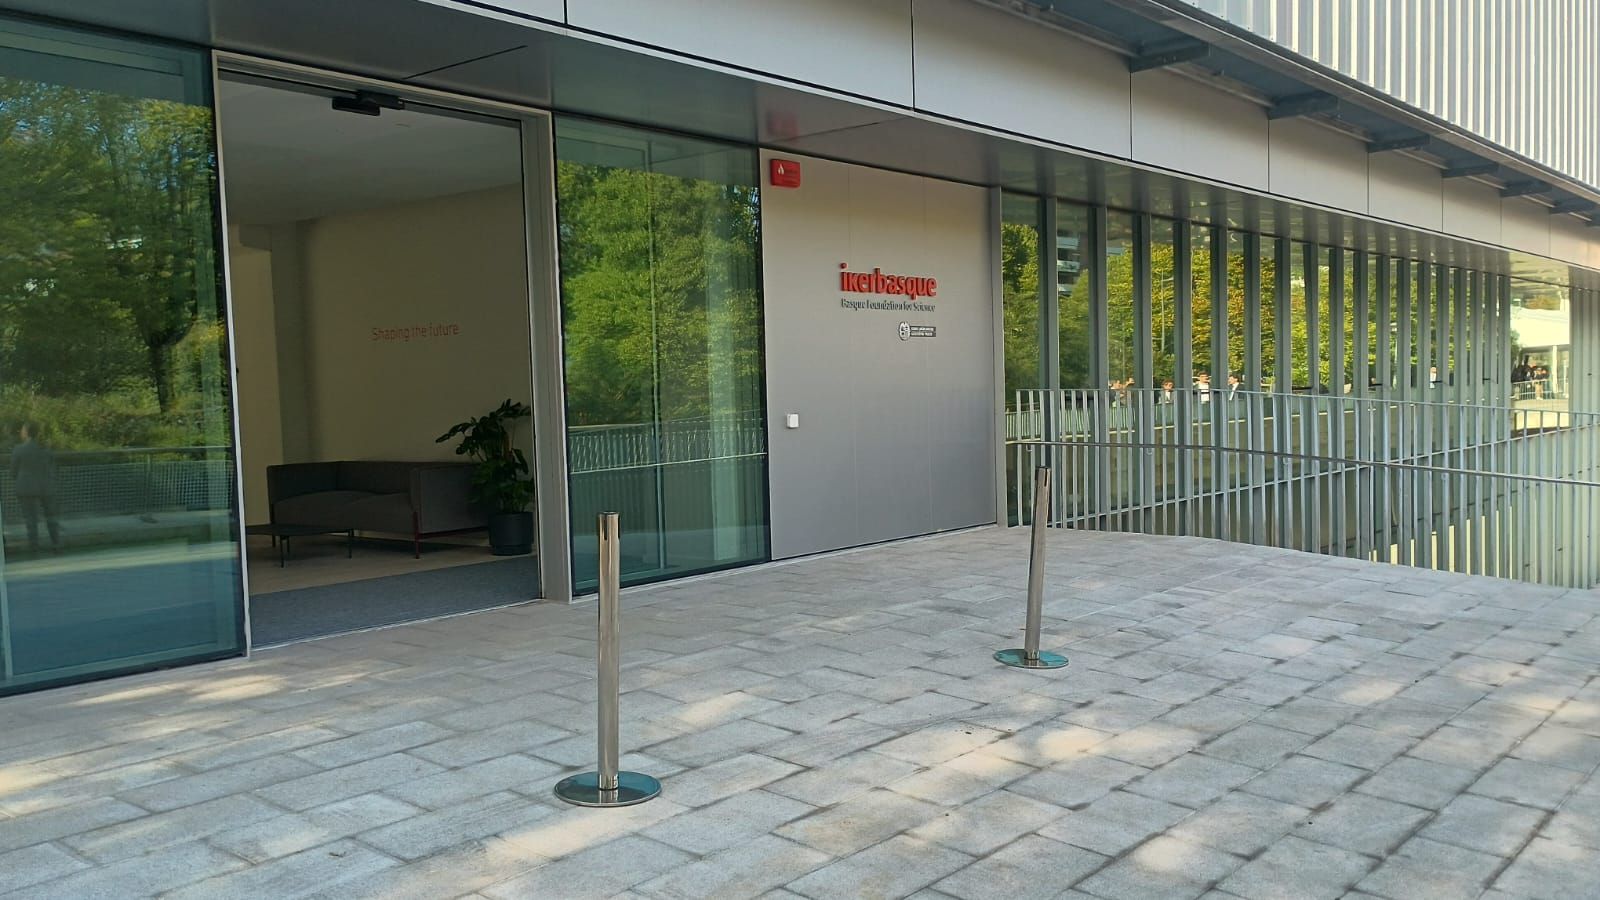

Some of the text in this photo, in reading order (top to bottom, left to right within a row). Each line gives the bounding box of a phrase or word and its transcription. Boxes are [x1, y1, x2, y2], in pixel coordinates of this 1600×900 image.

[839, 262, 937, 300] ikerbasque
[841, 298, 936, 313] Basque Foundation for Science
[371, 322, 460, 343] Shaping the future
